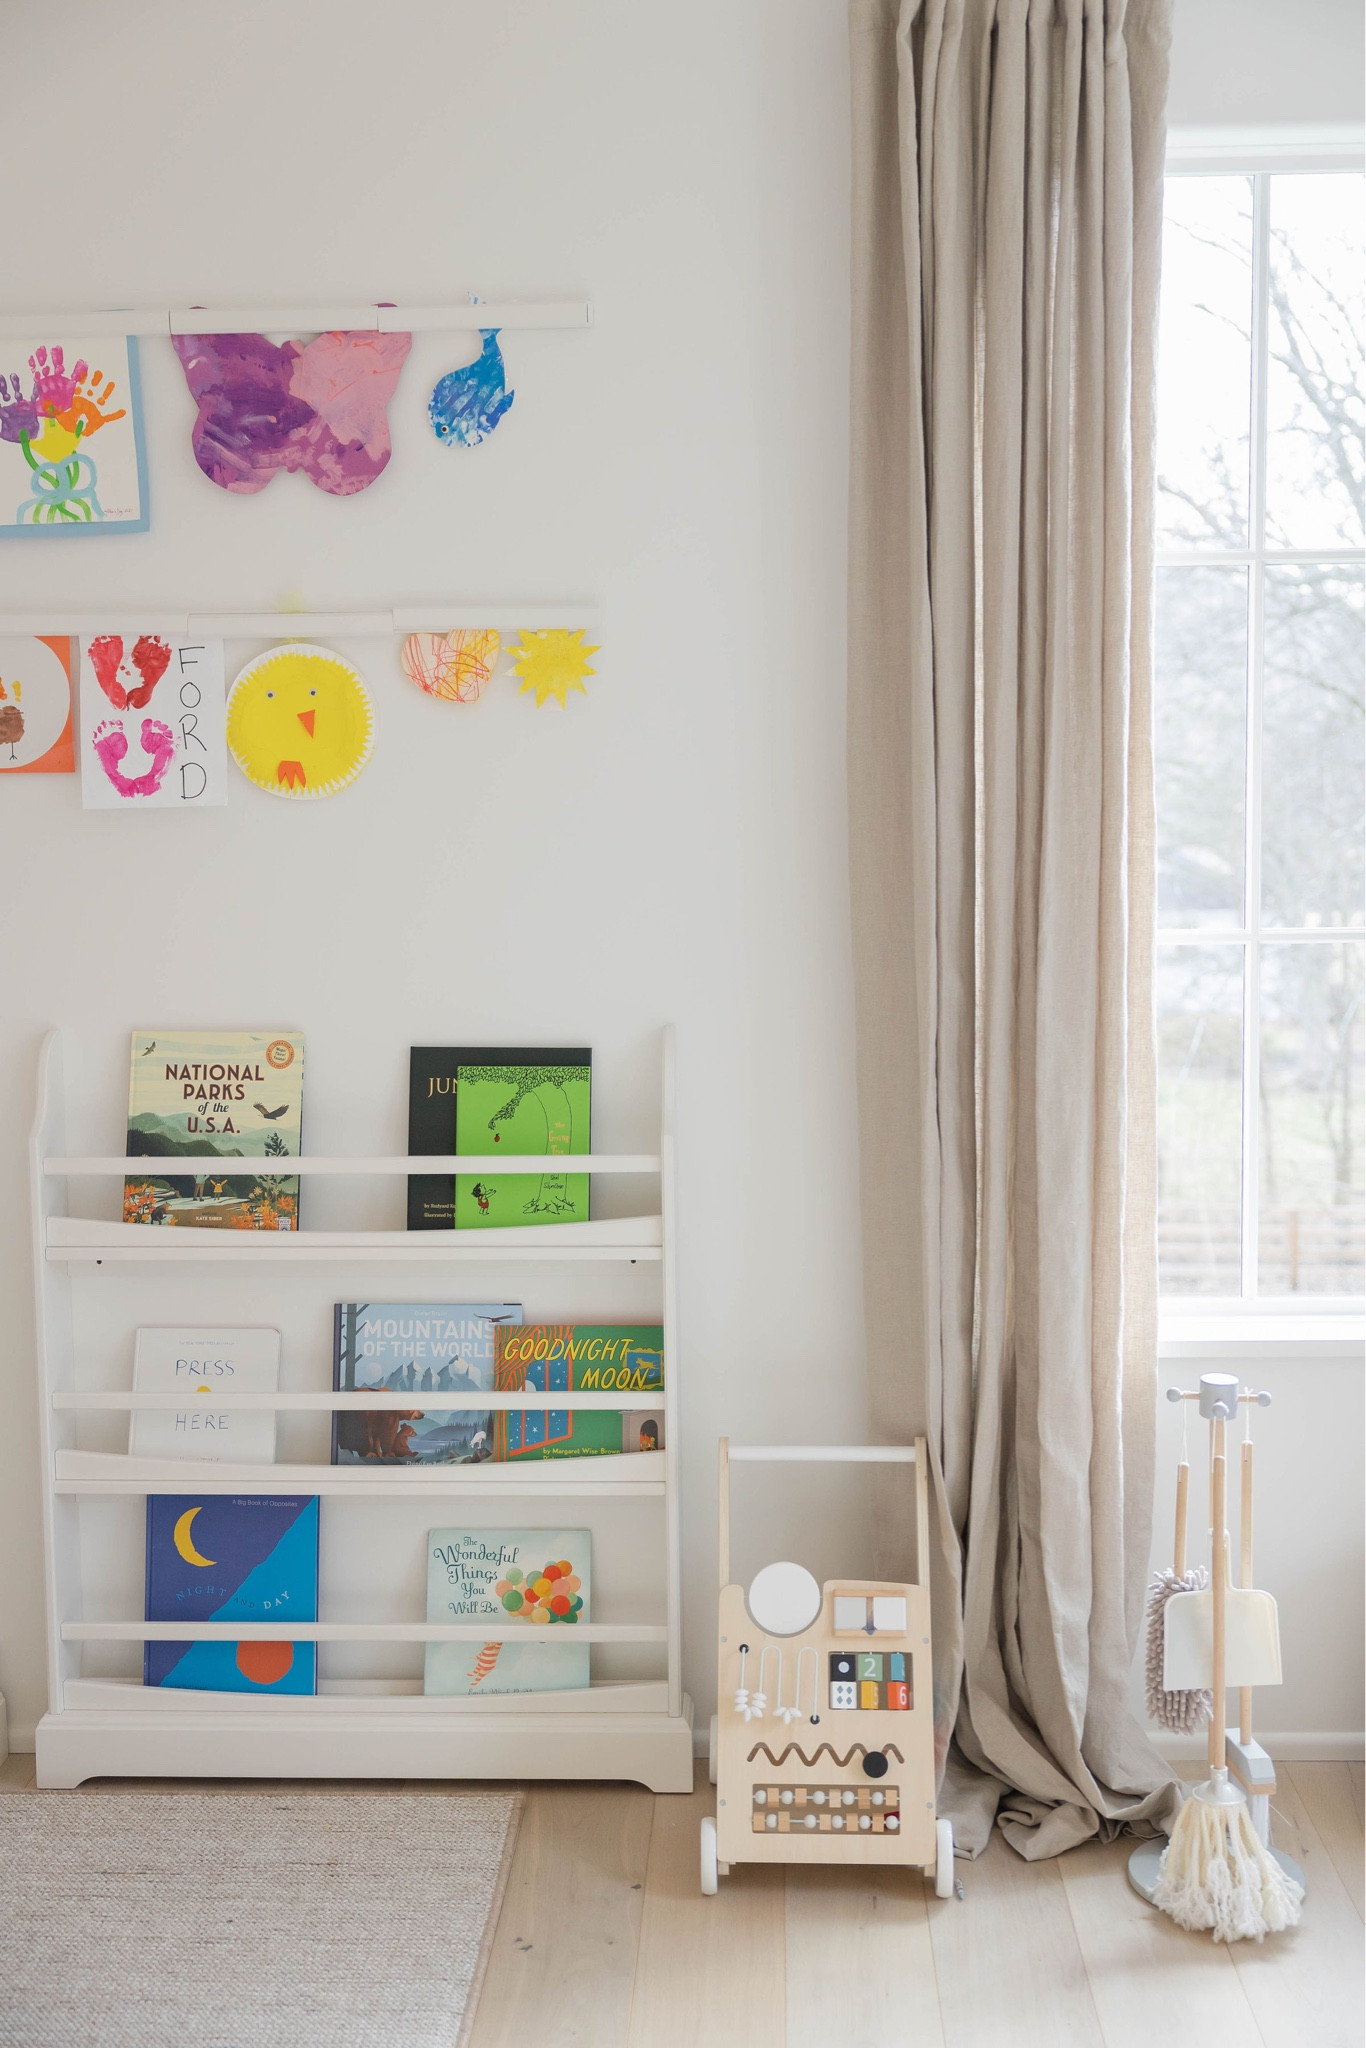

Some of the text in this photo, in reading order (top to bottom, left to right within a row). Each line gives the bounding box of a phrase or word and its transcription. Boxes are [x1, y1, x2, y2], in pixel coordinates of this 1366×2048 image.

[178, 646, 208, 799] FORD
[165, 1063, 265, 1081] NATIONAL
[183, 1083, 245, 1100] PARKS
[197, 1101, 229, 1115] of the
[187, 1116, 241, 1133] U.S.A.
[364, 1319, 495, 1339] MOUNTAINS
[363, 1341, 494, 1358] OF THE WORLD
[504, 1337, 634, 1361] GOODNIGHT
[176, 1359, 235, 1376] PRESS
[580, 1367, 650, 1389] MOON
[175, 1413, 229, 1431] HERE
[552, 1447, 580, 1455] Margaret
[463, 1536, 478, 1547] The
[433, 1543, 519, 1566] Wonderful
[447, 1563, 498, 1584] Things
[175, 1585, 290, 1609] NIGHT AND DAY
[461, 1582, 486, 1599] You
[448, 1600, 499, 1615] Will Be
[863, 1657, 876, 1677] 2
[899, 1685, 907, 1706] 6
